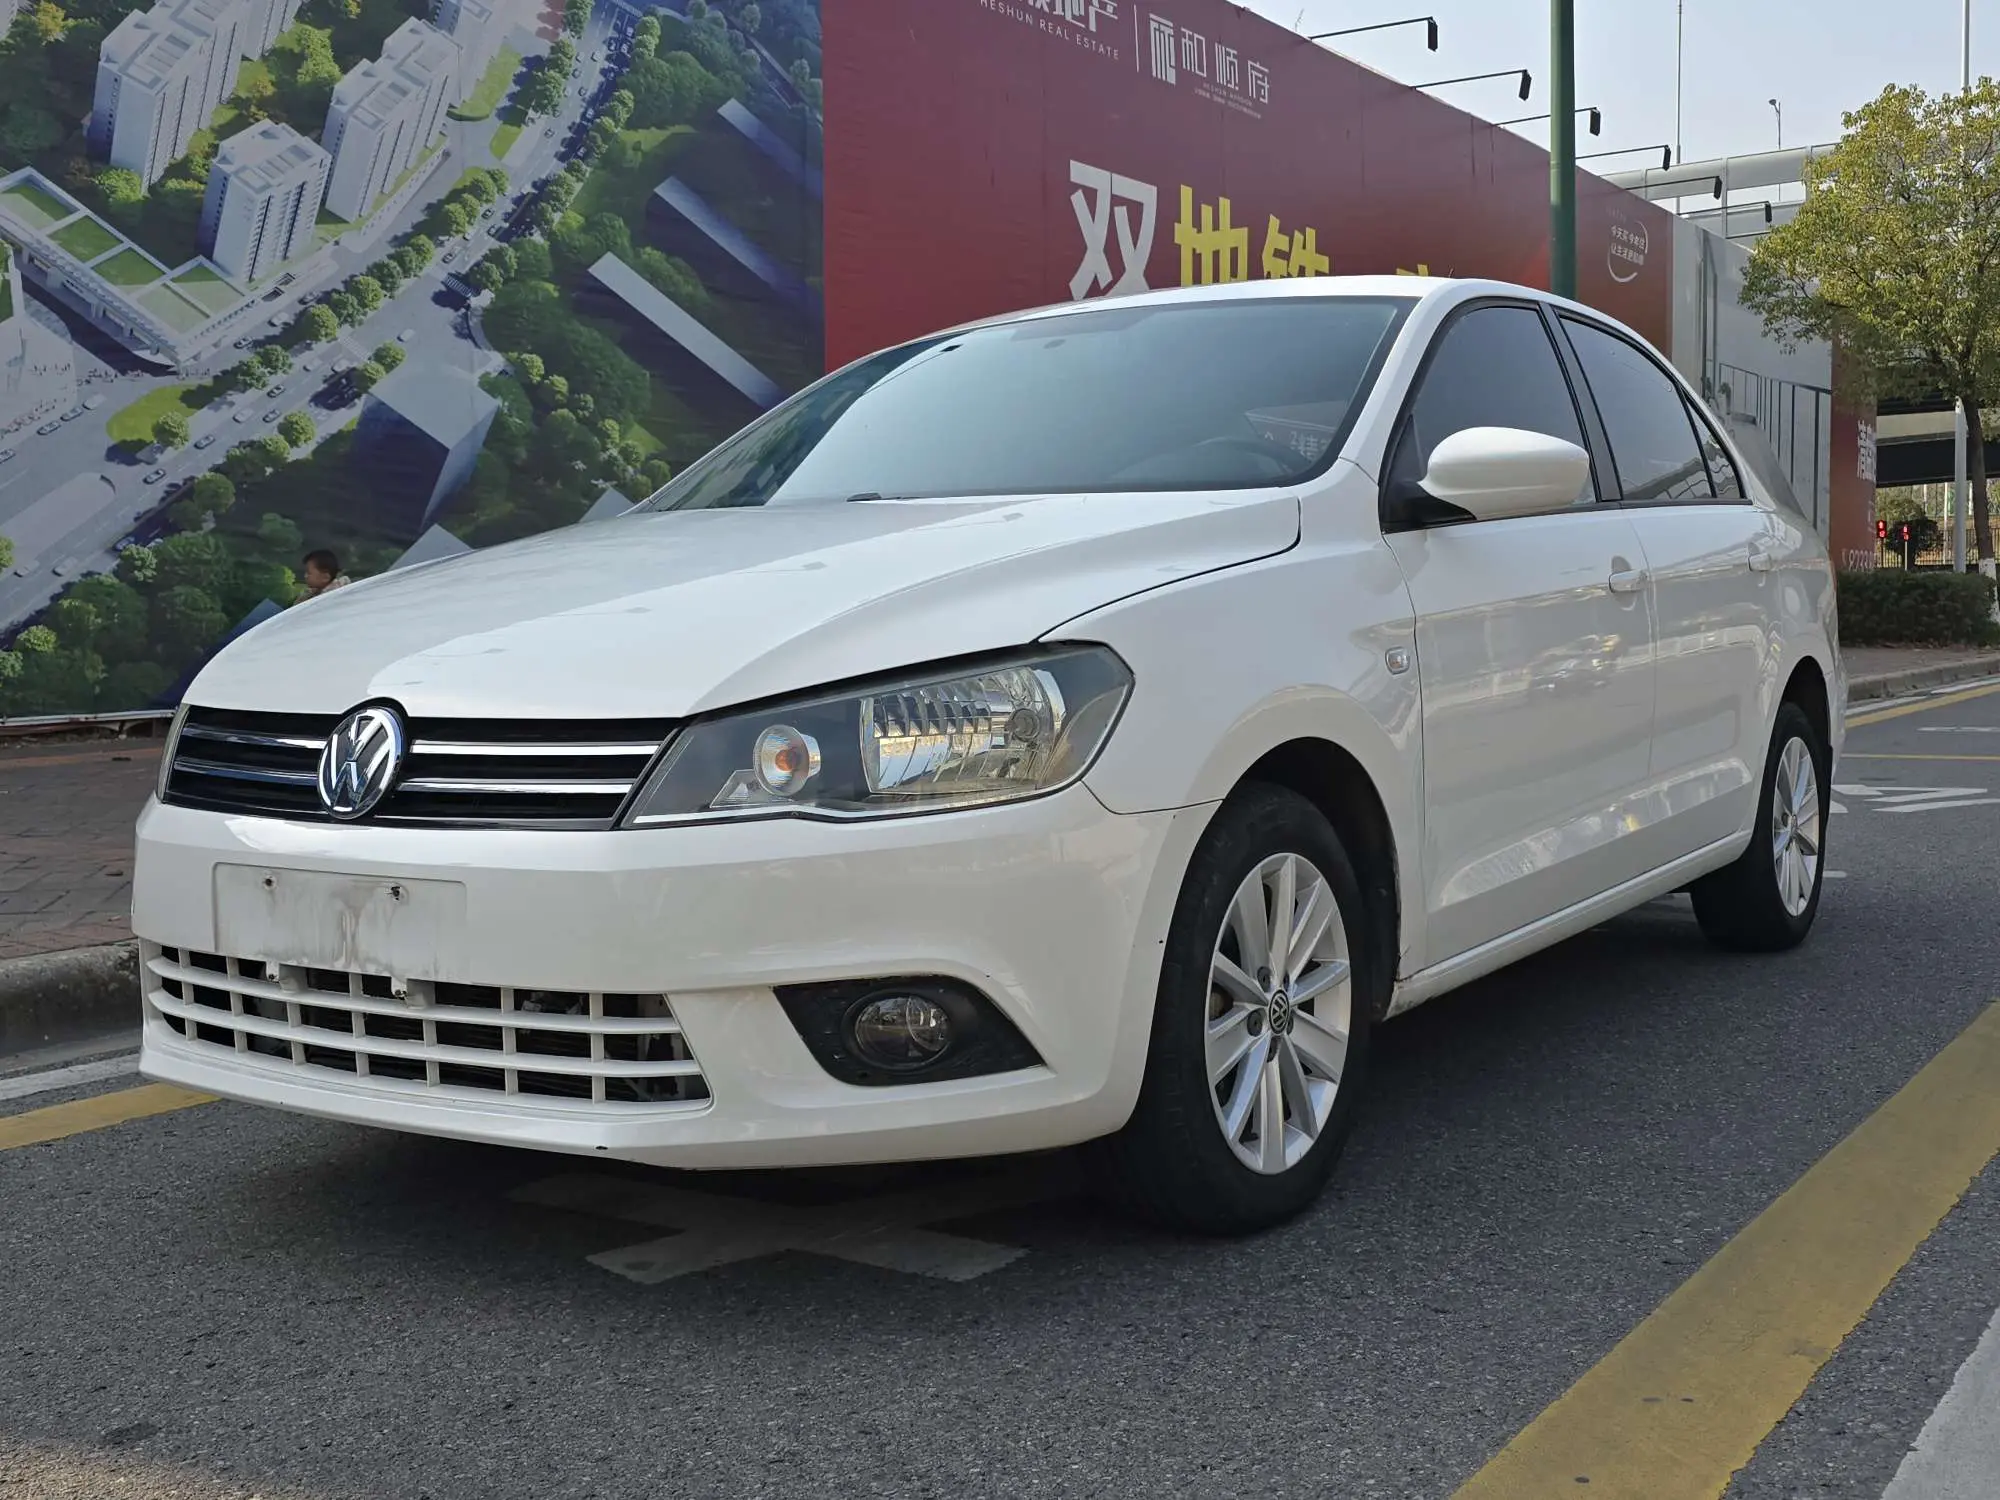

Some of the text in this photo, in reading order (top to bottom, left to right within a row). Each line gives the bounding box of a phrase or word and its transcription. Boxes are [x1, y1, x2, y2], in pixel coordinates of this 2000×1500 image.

[980, 0, 1120, 61] HESHUN REAL ESTATE
[1019, 0, 1119, 32] 地产
